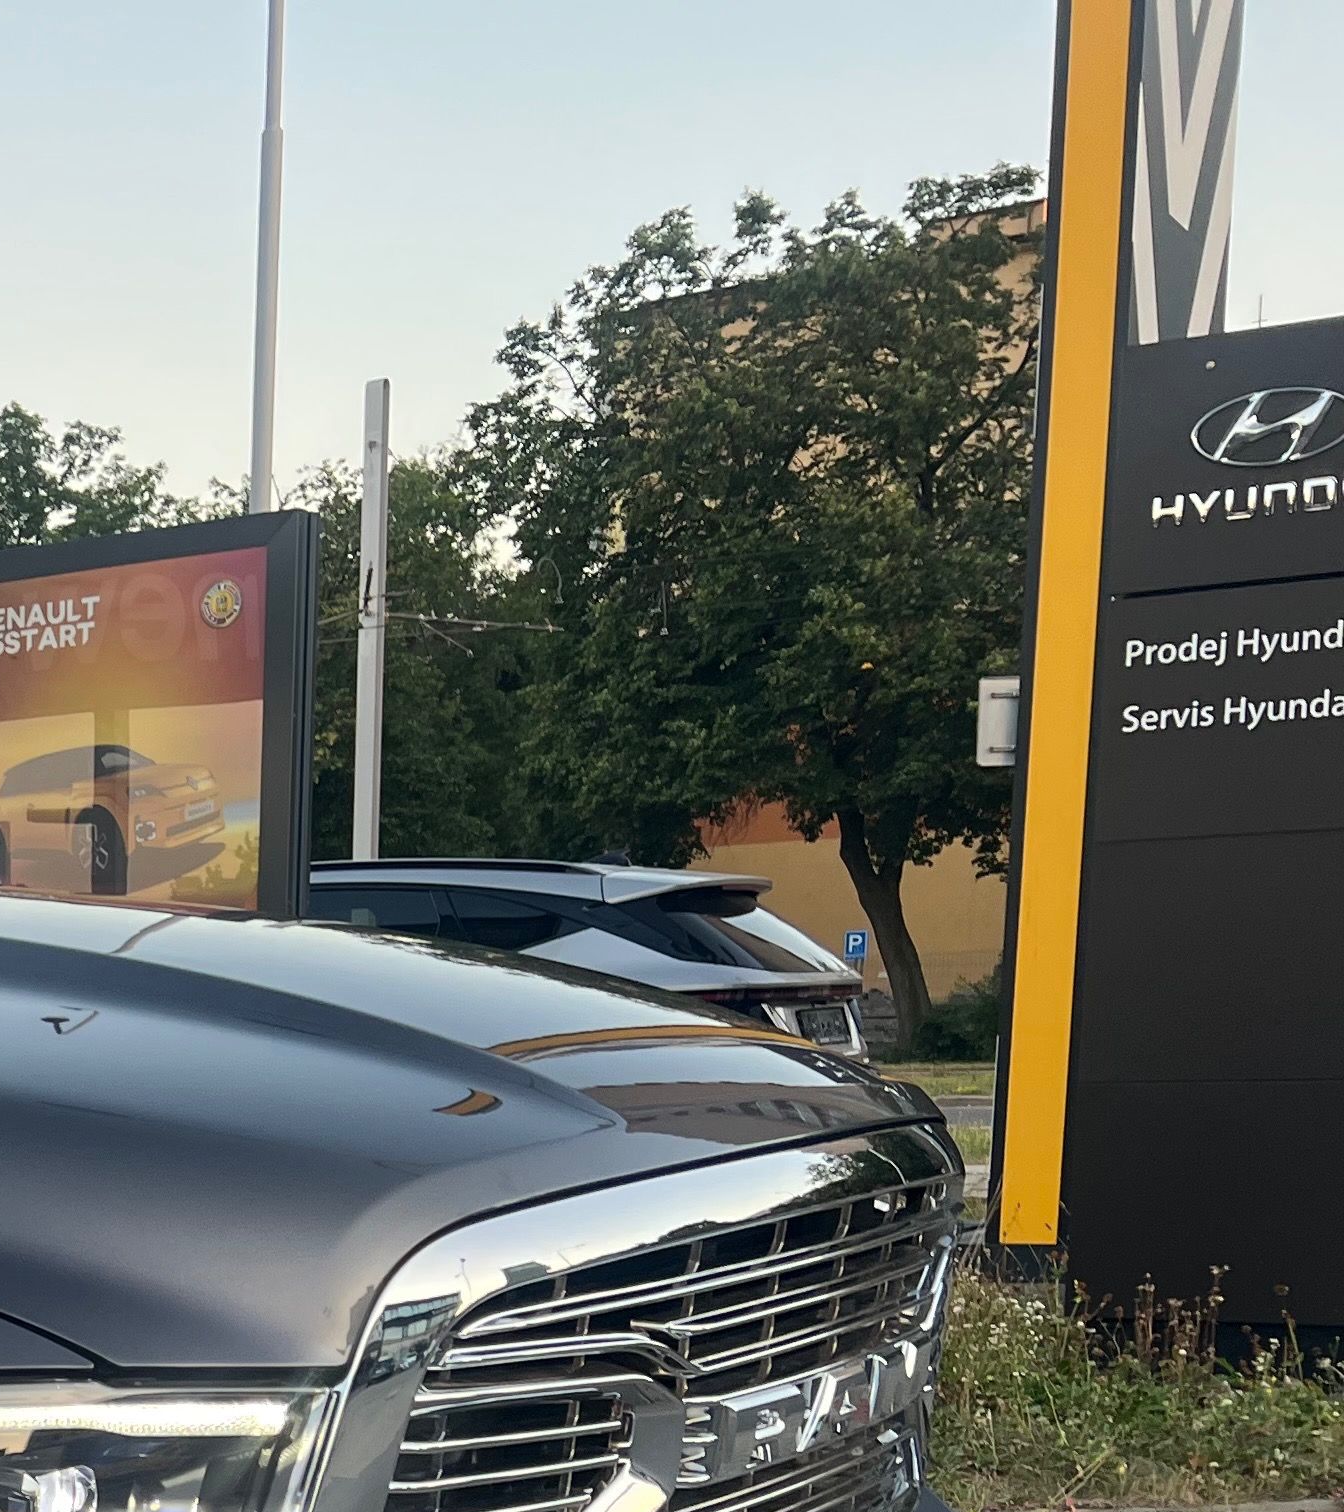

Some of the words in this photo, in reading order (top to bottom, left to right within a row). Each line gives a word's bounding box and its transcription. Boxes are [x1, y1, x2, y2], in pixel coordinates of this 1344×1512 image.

[1151, 475, 1344, 529] HYUND
[1125, 631, 1228, 667] Prodej
[1122, 700, 1214, 733] Servis
[849, 934, 863, 953] P
